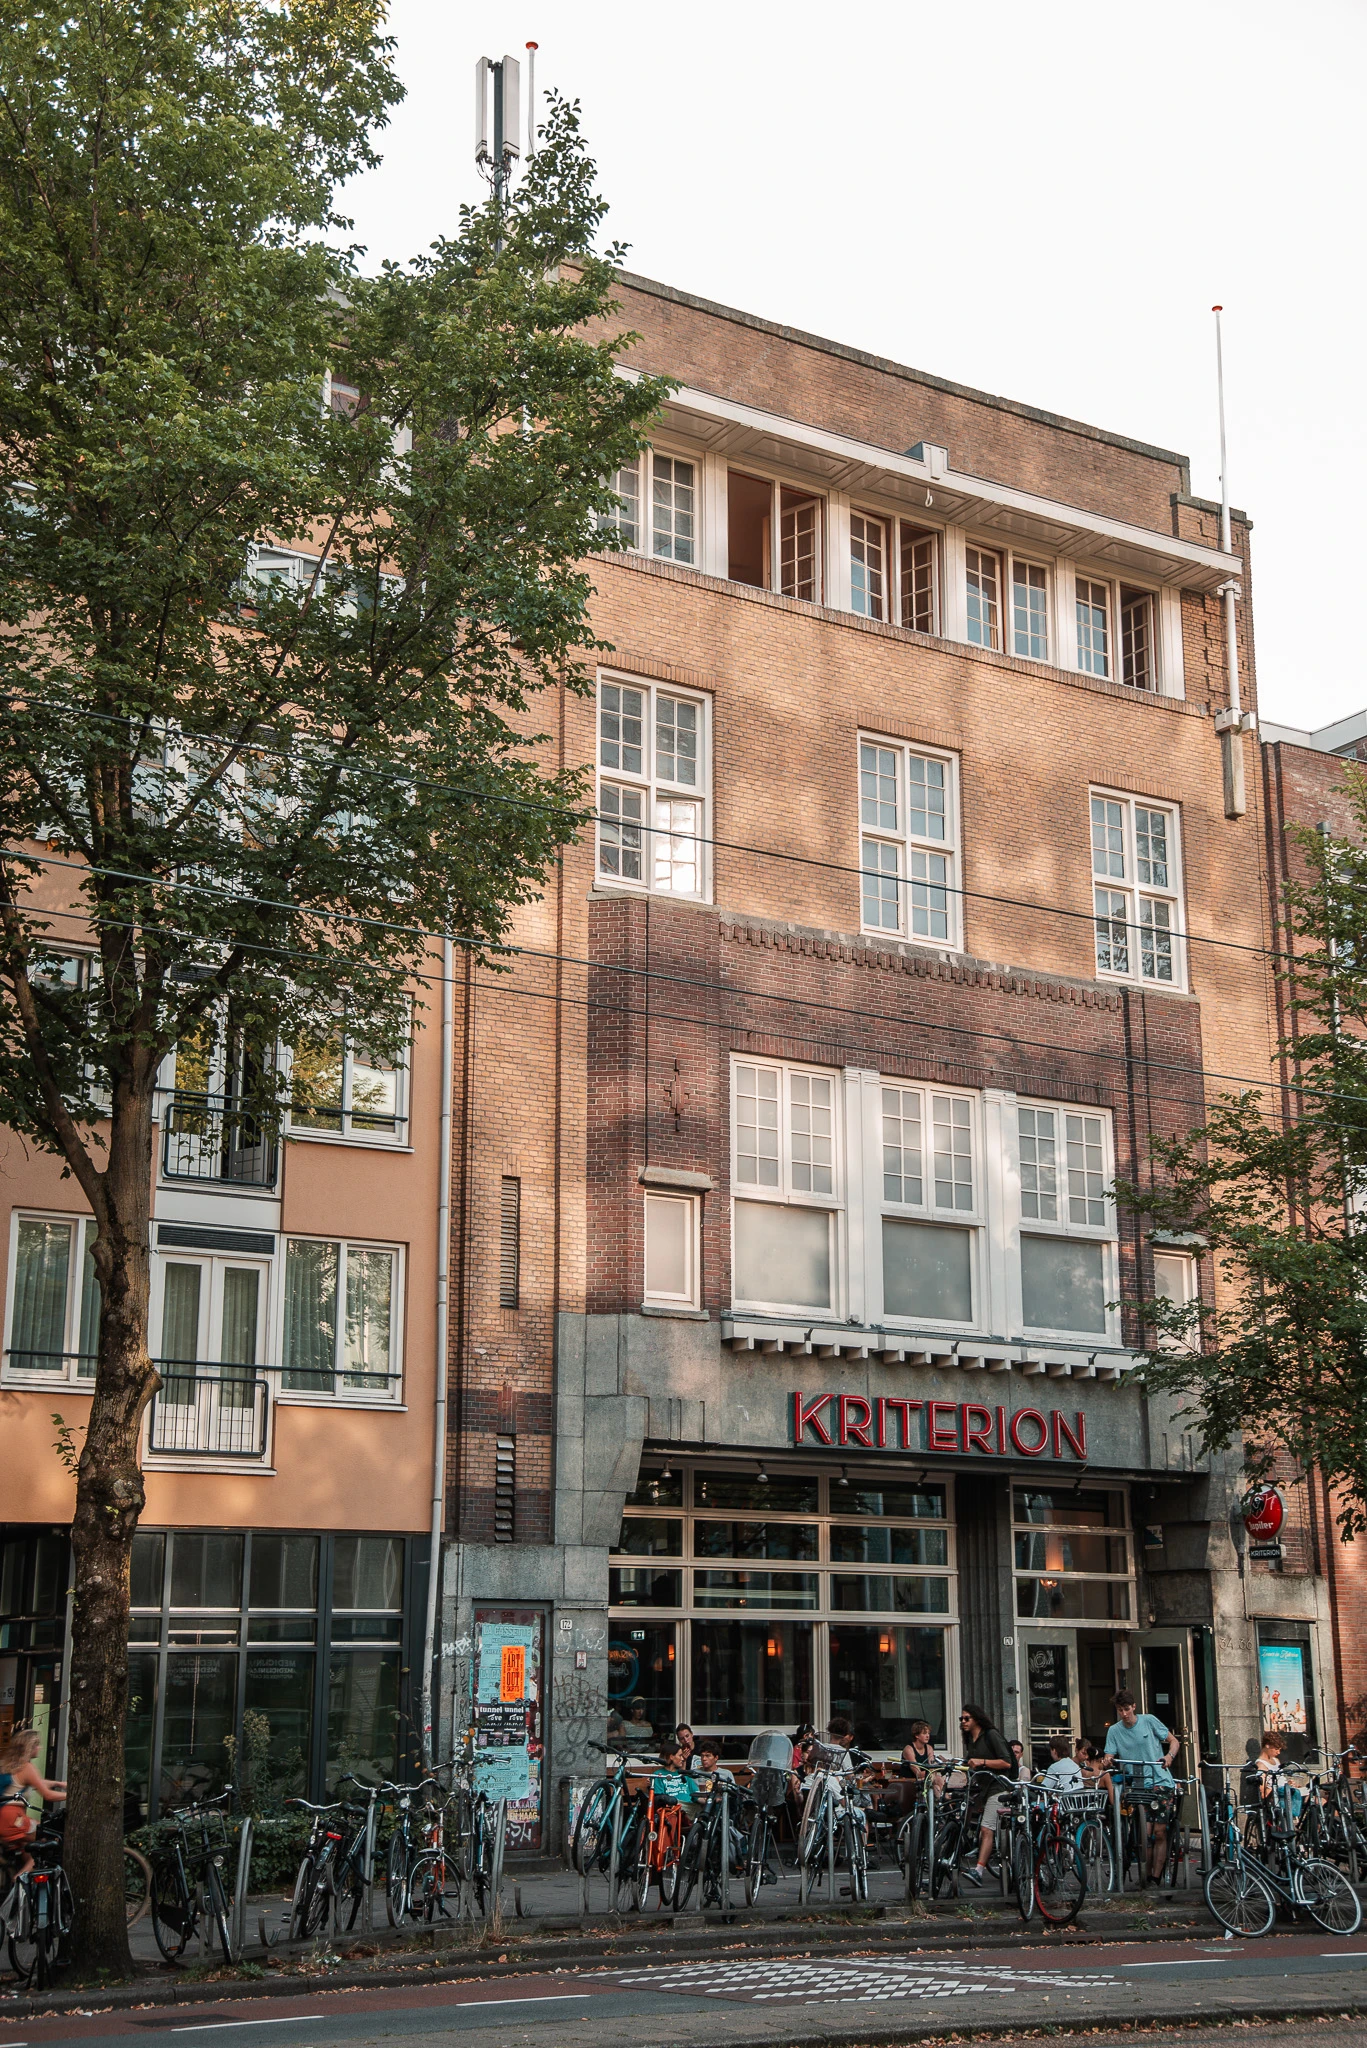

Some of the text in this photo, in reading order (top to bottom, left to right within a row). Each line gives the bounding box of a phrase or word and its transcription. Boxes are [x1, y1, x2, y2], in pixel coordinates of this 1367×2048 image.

[792, 1391, 1088, 1460] KRITERION
[1248, 1521, 1274, 1531] Jupiler
[1250, 1549, 1280, 1557] KRITERION
[561, 1620, 571, 1629] 172
[507, 1653, 520, 1668] ART
[507, 1672, 520, 1686] OUT
